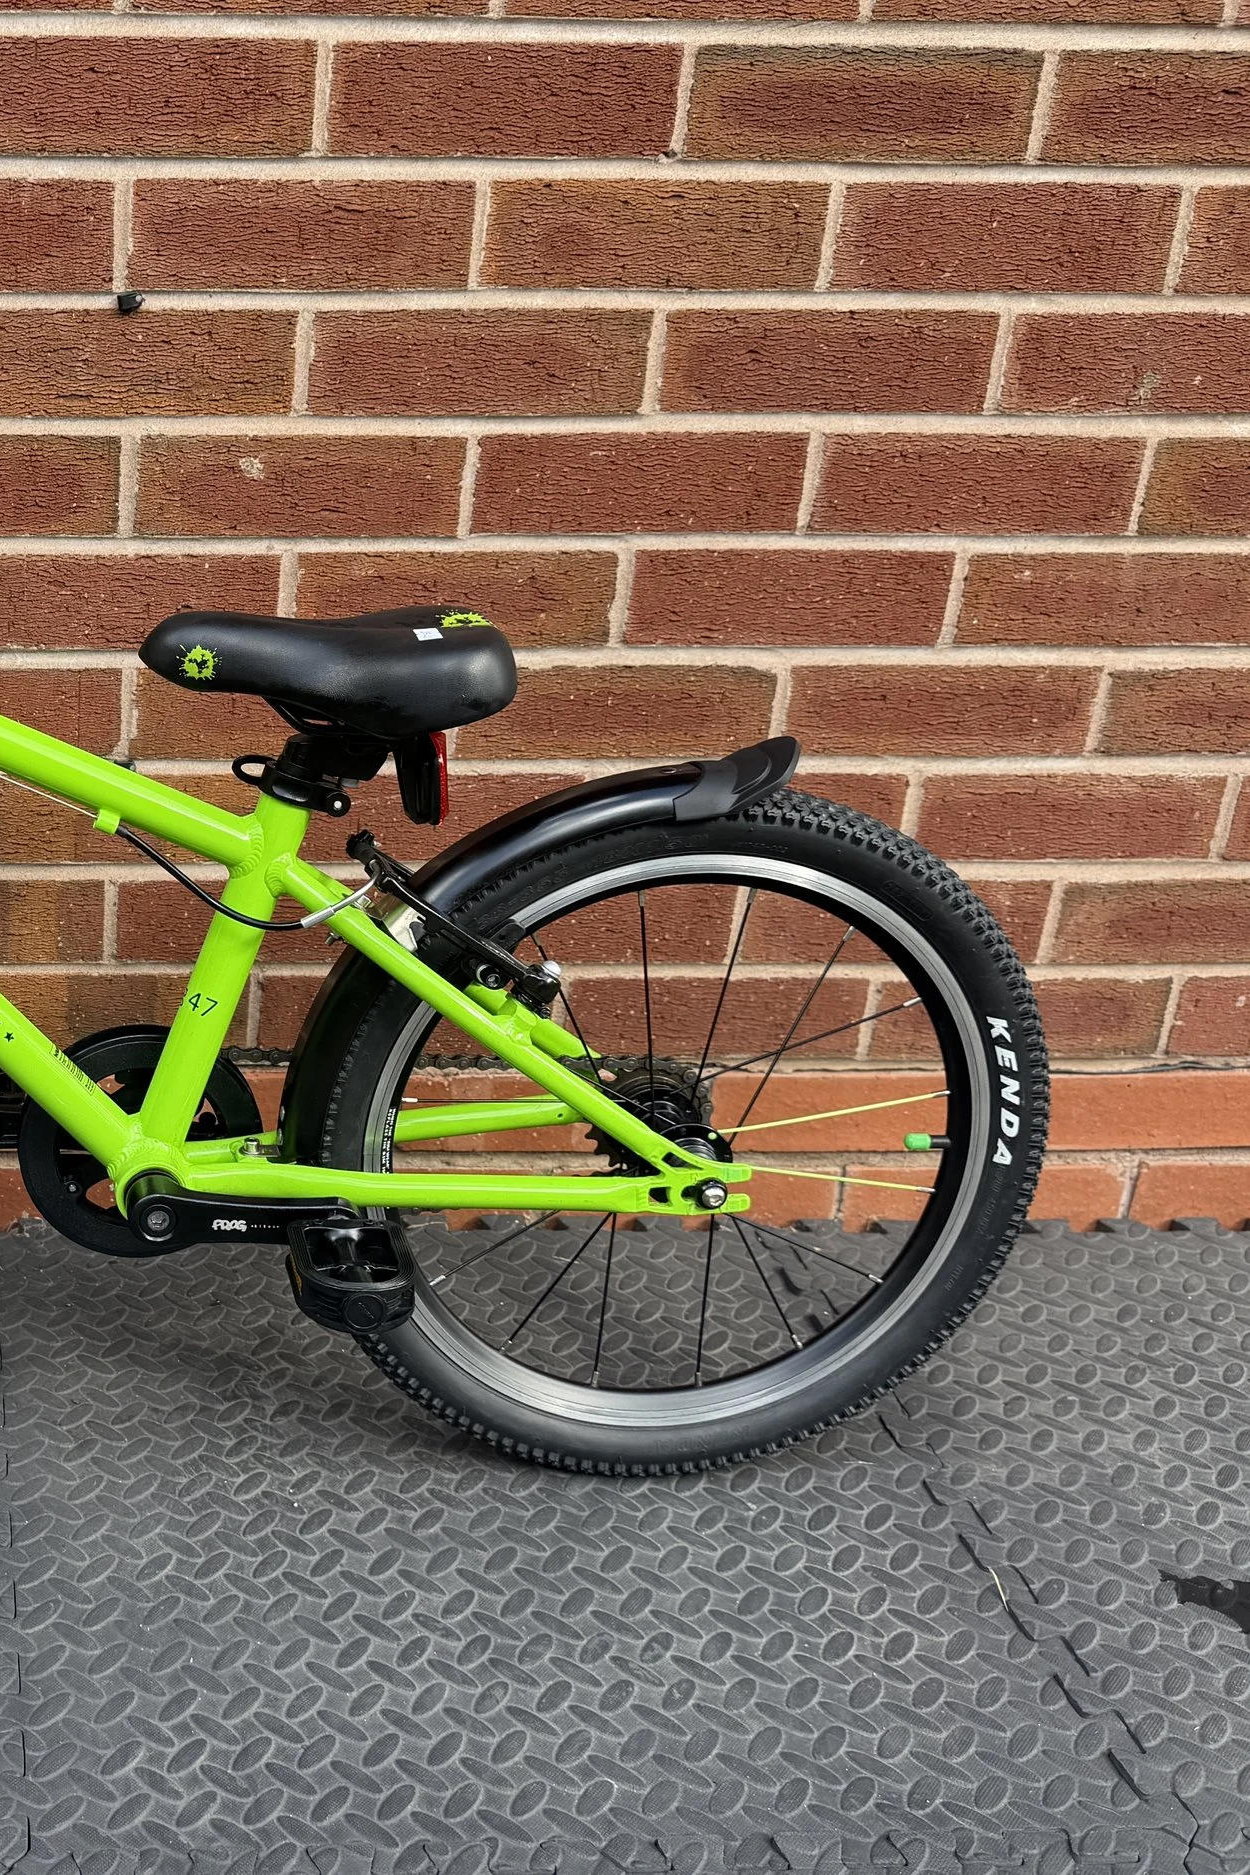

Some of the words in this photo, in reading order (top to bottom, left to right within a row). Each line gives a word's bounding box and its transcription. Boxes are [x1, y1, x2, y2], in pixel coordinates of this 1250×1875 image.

[188, 993, 218, 1017] 47
[986, 1016, 1020, 1166] KENDA
[211, 1219, 248, 1232] FROG
